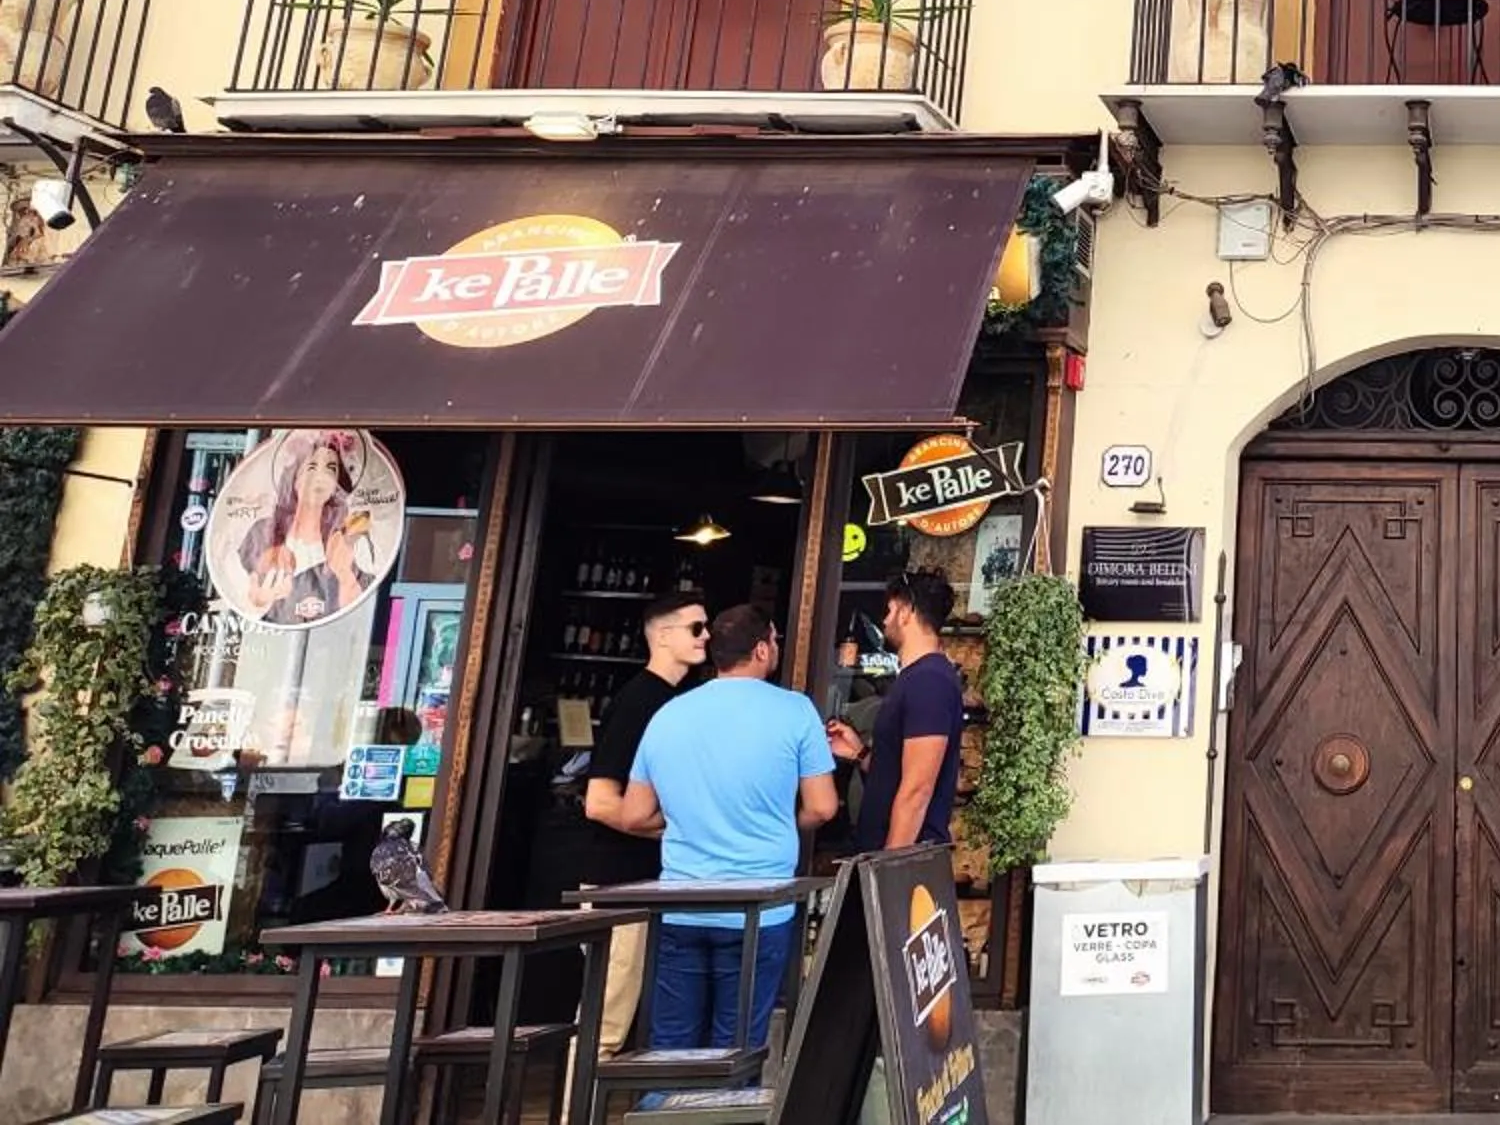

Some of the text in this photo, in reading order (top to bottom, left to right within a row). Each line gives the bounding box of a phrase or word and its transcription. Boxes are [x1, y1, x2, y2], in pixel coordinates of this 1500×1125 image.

[413, 253, 629, 309] ke Palle
[1107, 454, 1145, 476] 270
[896, 465, 993, 508] ke Palle
[1088, 562, 1199, 576] DIMORA BELLINI
[133, 891, 211, 926] ke Palle
[1083, 921, 1149, 938] VETRO
[1073, 941, 1113, 952] VERRE
[1123, 940, 1158, 950] COPA
[1095, 953, 1135, 964] GLASS
